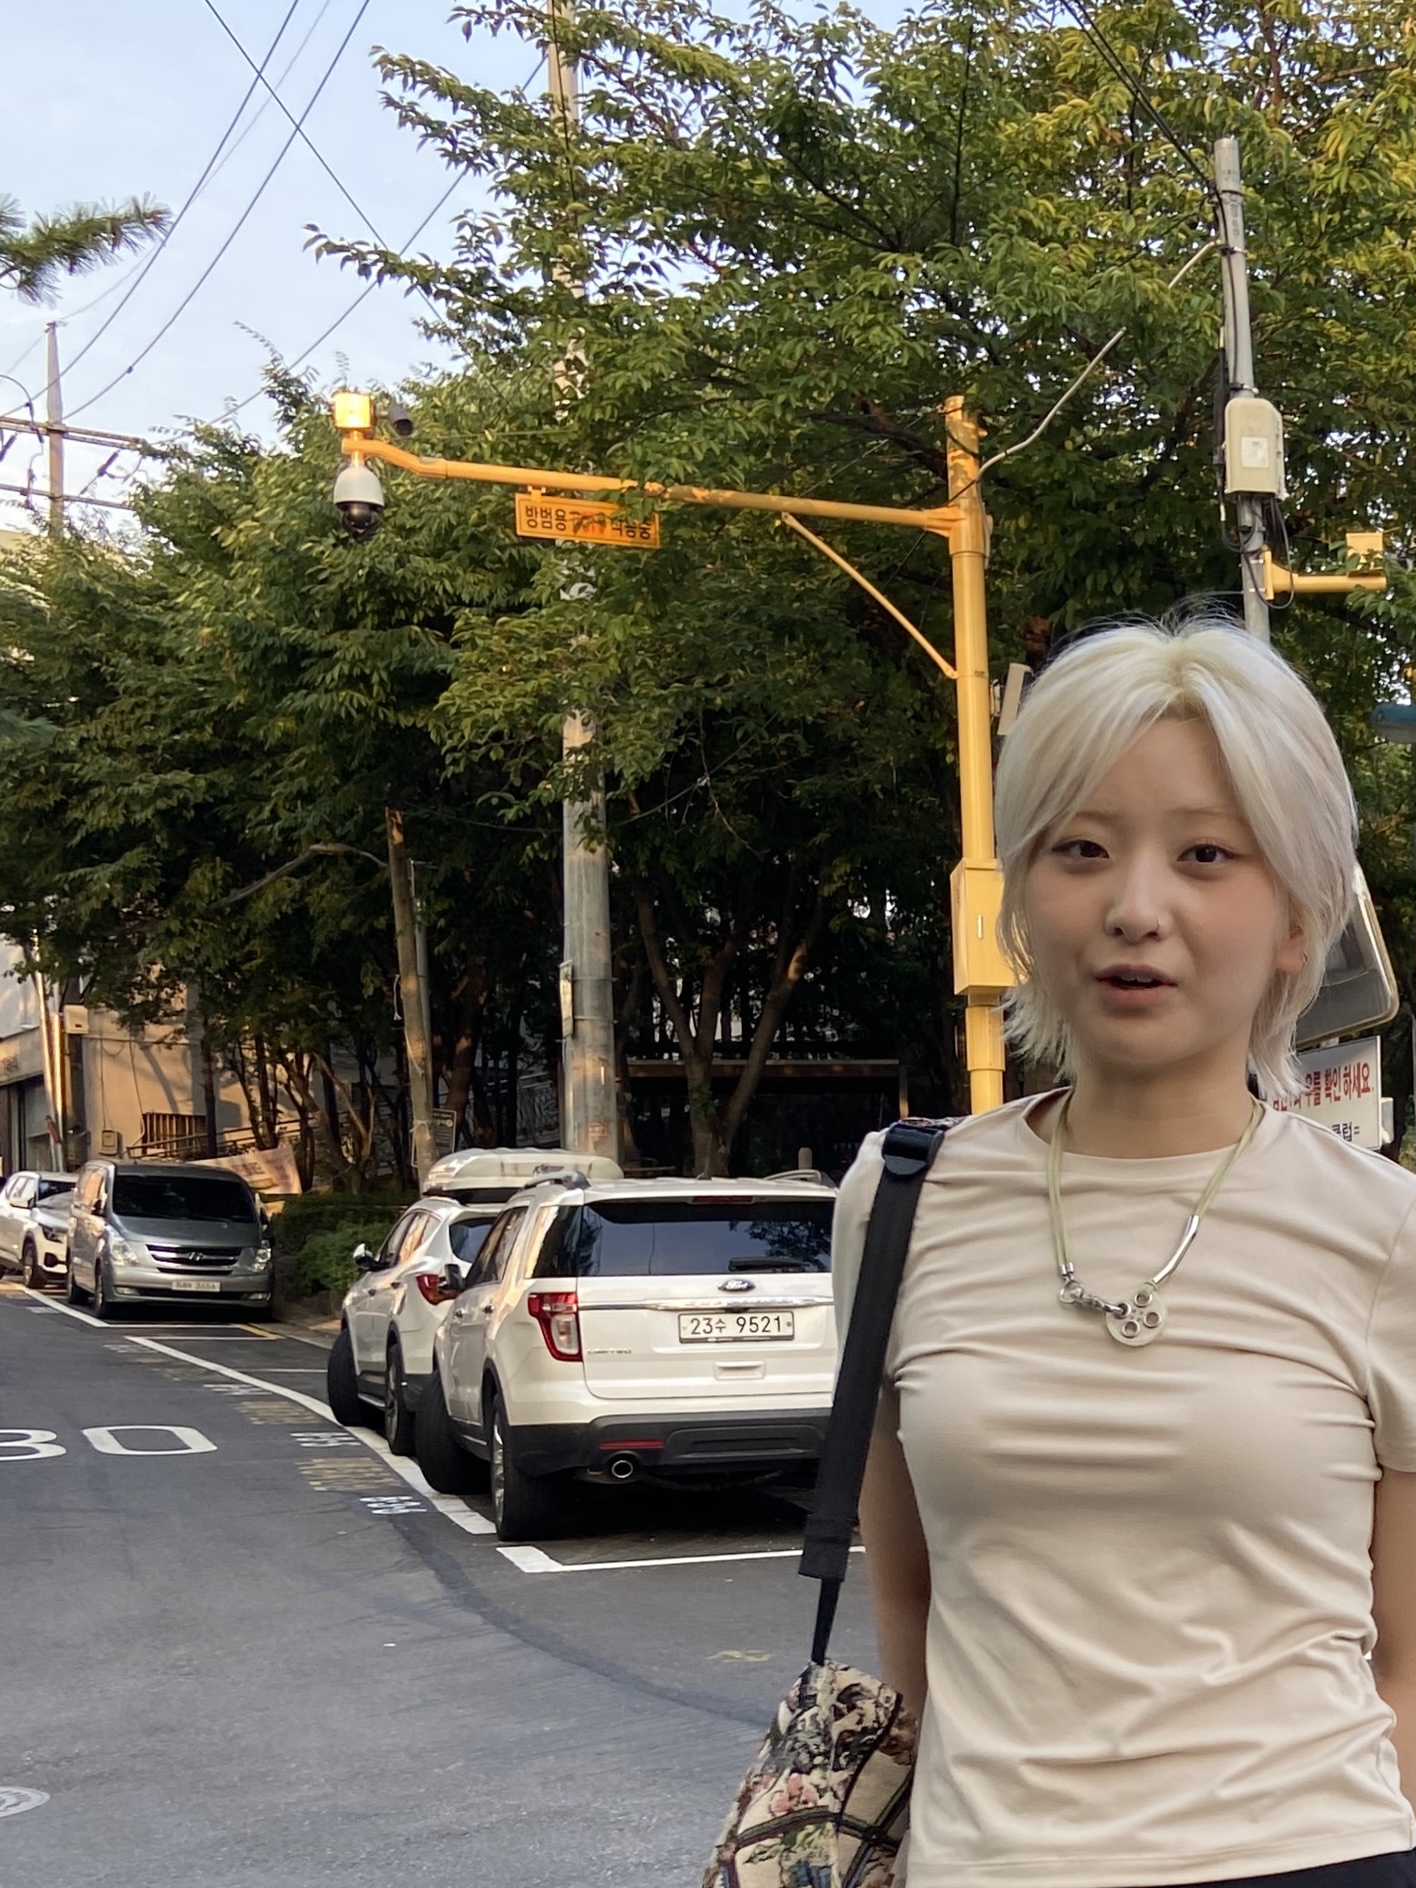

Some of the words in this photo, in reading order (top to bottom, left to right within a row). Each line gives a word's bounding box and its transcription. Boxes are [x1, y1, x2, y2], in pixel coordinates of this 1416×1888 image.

[526, 505, 567, 532] 방범용
[690, 1317, 726, 1335] 23수
[736, 1315, 782, 1334] 9521
